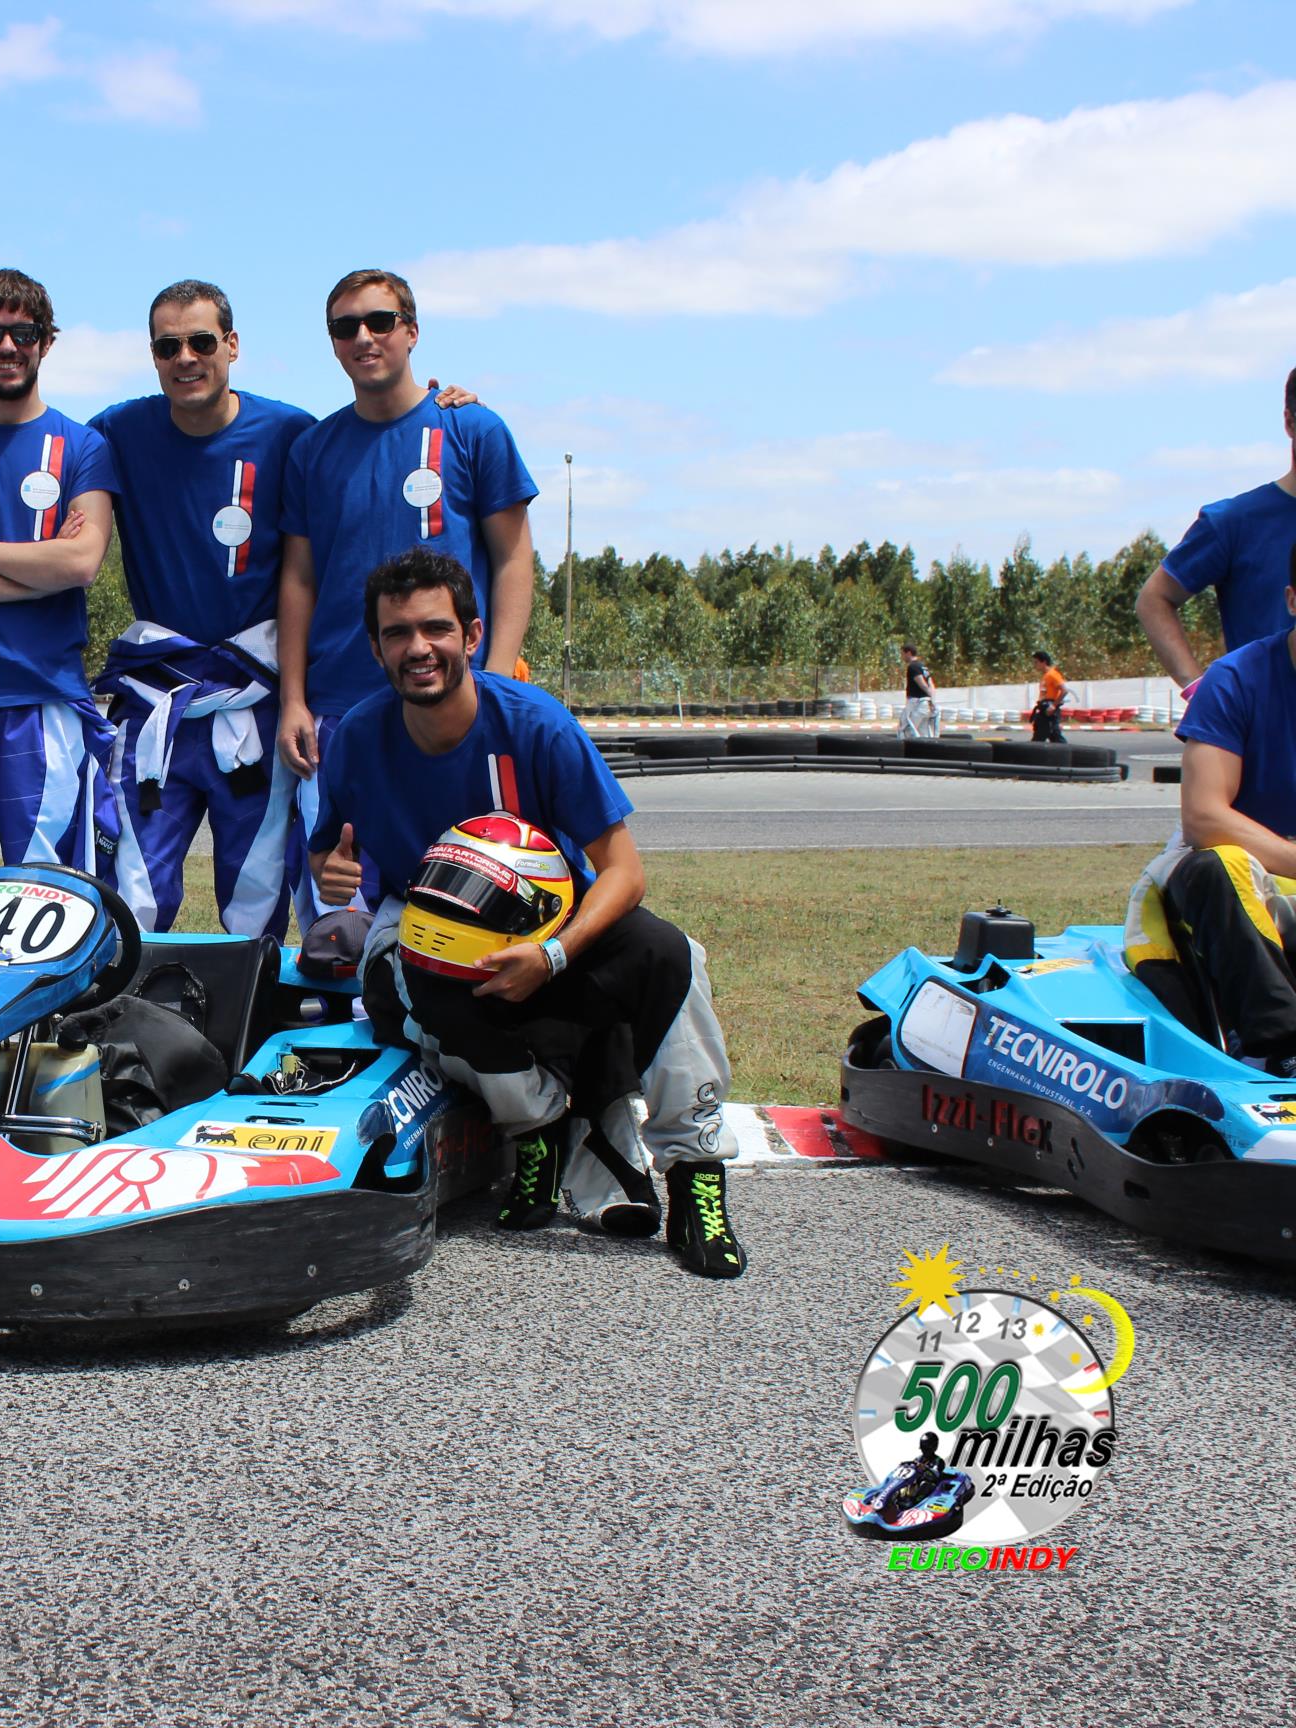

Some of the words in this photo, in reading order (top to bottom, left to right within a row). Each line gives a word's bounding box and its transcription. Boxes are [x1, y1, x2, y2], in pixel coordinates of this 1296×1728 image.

[983, 1015, 1129, 1110] TECNIROLO
[987, 1058, 1031, 1086] ENGENHARIA
[247, 1130, 327, 1152] eni
